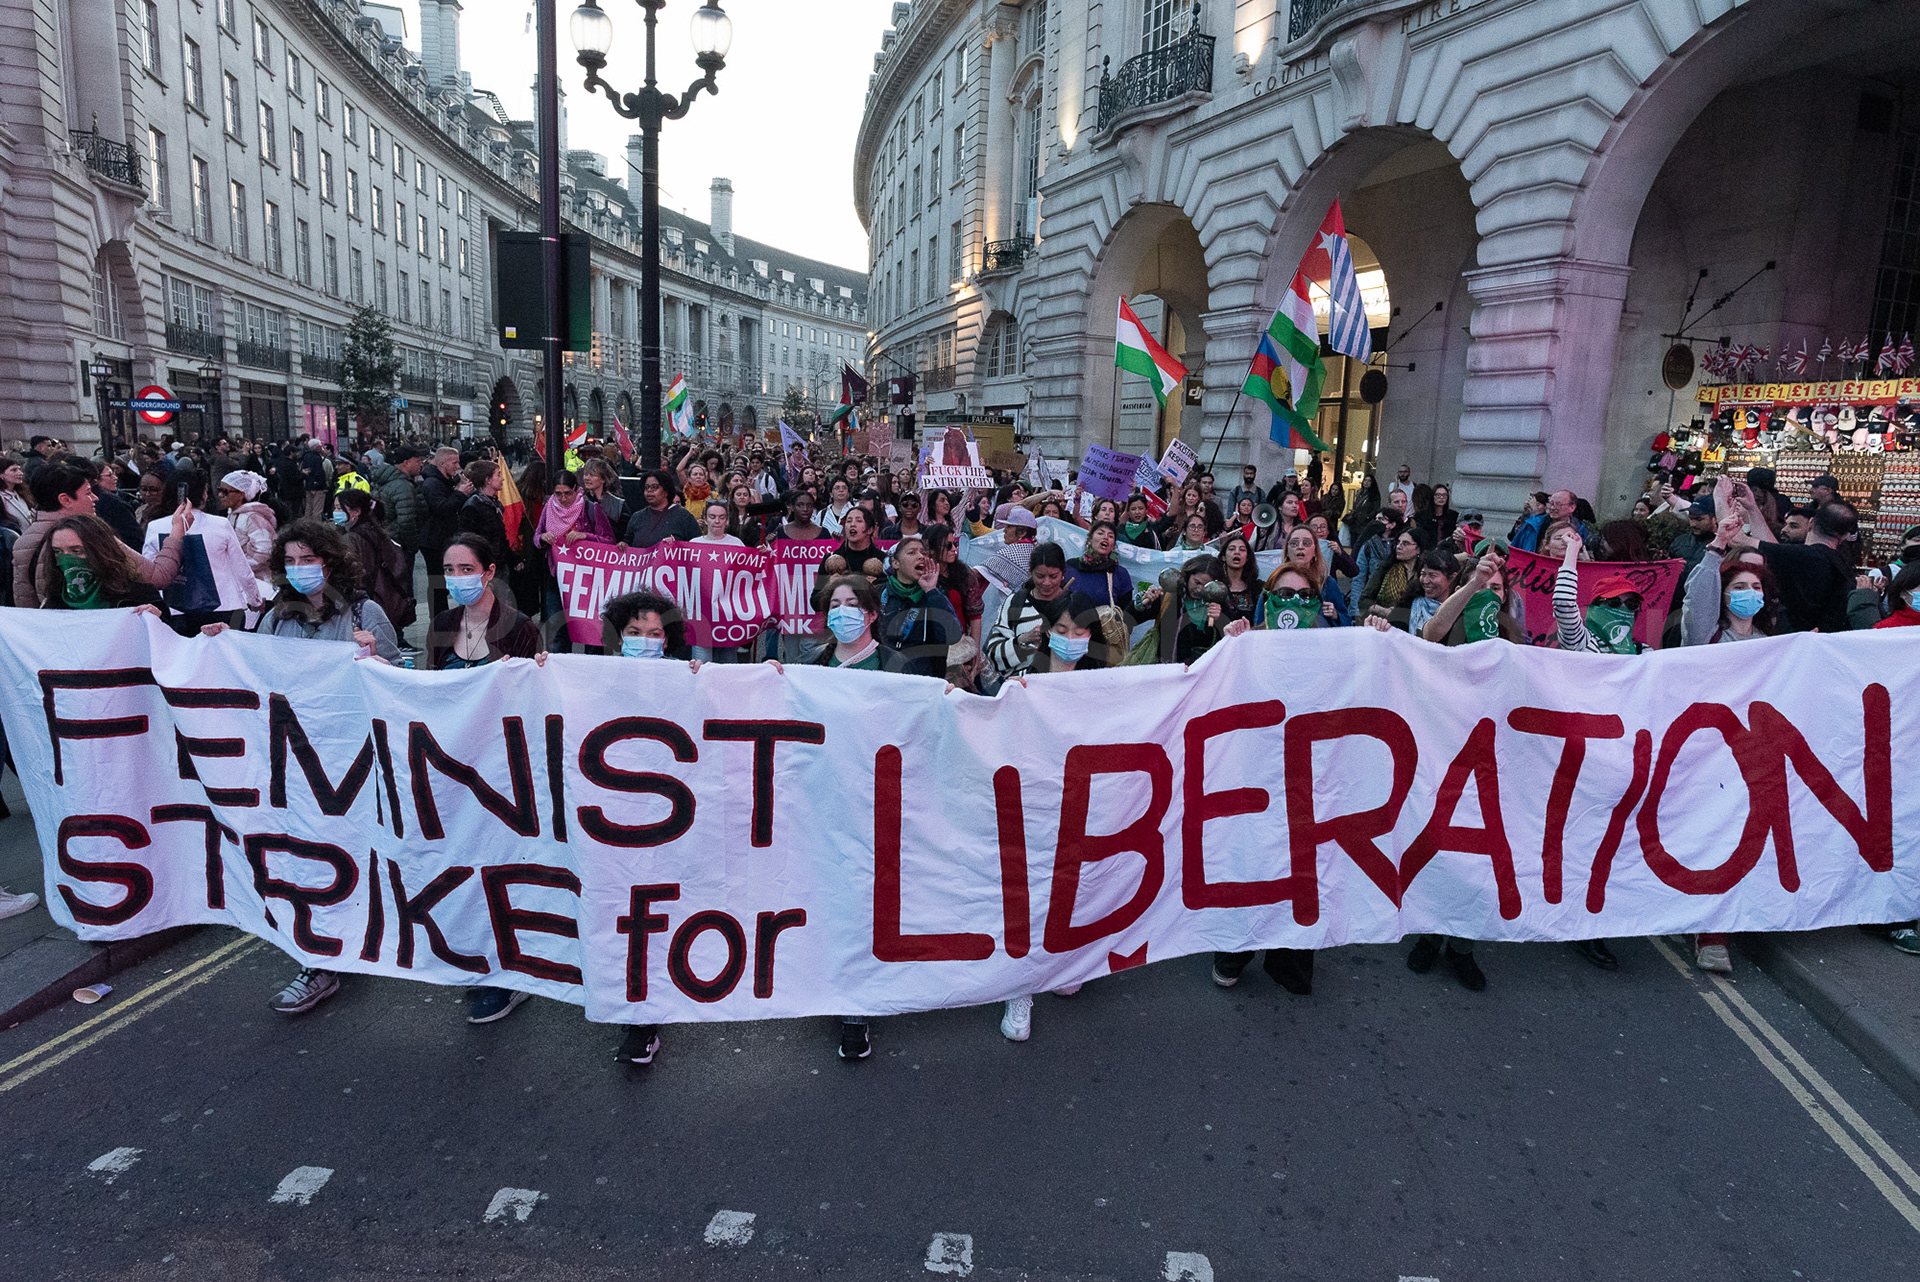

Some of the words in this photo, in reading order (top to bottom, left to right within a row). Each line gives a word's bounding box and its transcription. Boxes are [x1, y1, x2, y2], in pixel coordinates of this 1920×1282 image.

[1721, 386, 1738, 399] £1
[1744, 386, 1761, 399] £1
[1766, 386, 1784, 399] £1
[1792, 385, 1810, 397] £1
[1817, 384, 1837, 396] £1
[1844, 382, 1864, 395] £1
[1871, 383, 1890, 396] £1
[131, 401, 180, 409] UNDERGROUND
[972, 416, 1000, 424] FALAFEL
[931, 466, 961, 476] FUCK
[961, 466, 986, 477] THE
[923, 477, 994, 488] PATRIARCHY
[664, 547, 701, 562] WITH
[711, 569, 771, 622] NOT
[37, 667, 826, 847] FEMINIST
[871, 682, 1894, 963] LIBERATION
[57, 803, 584, 986] STRIKE
[616, 882, 807, 1003] for
